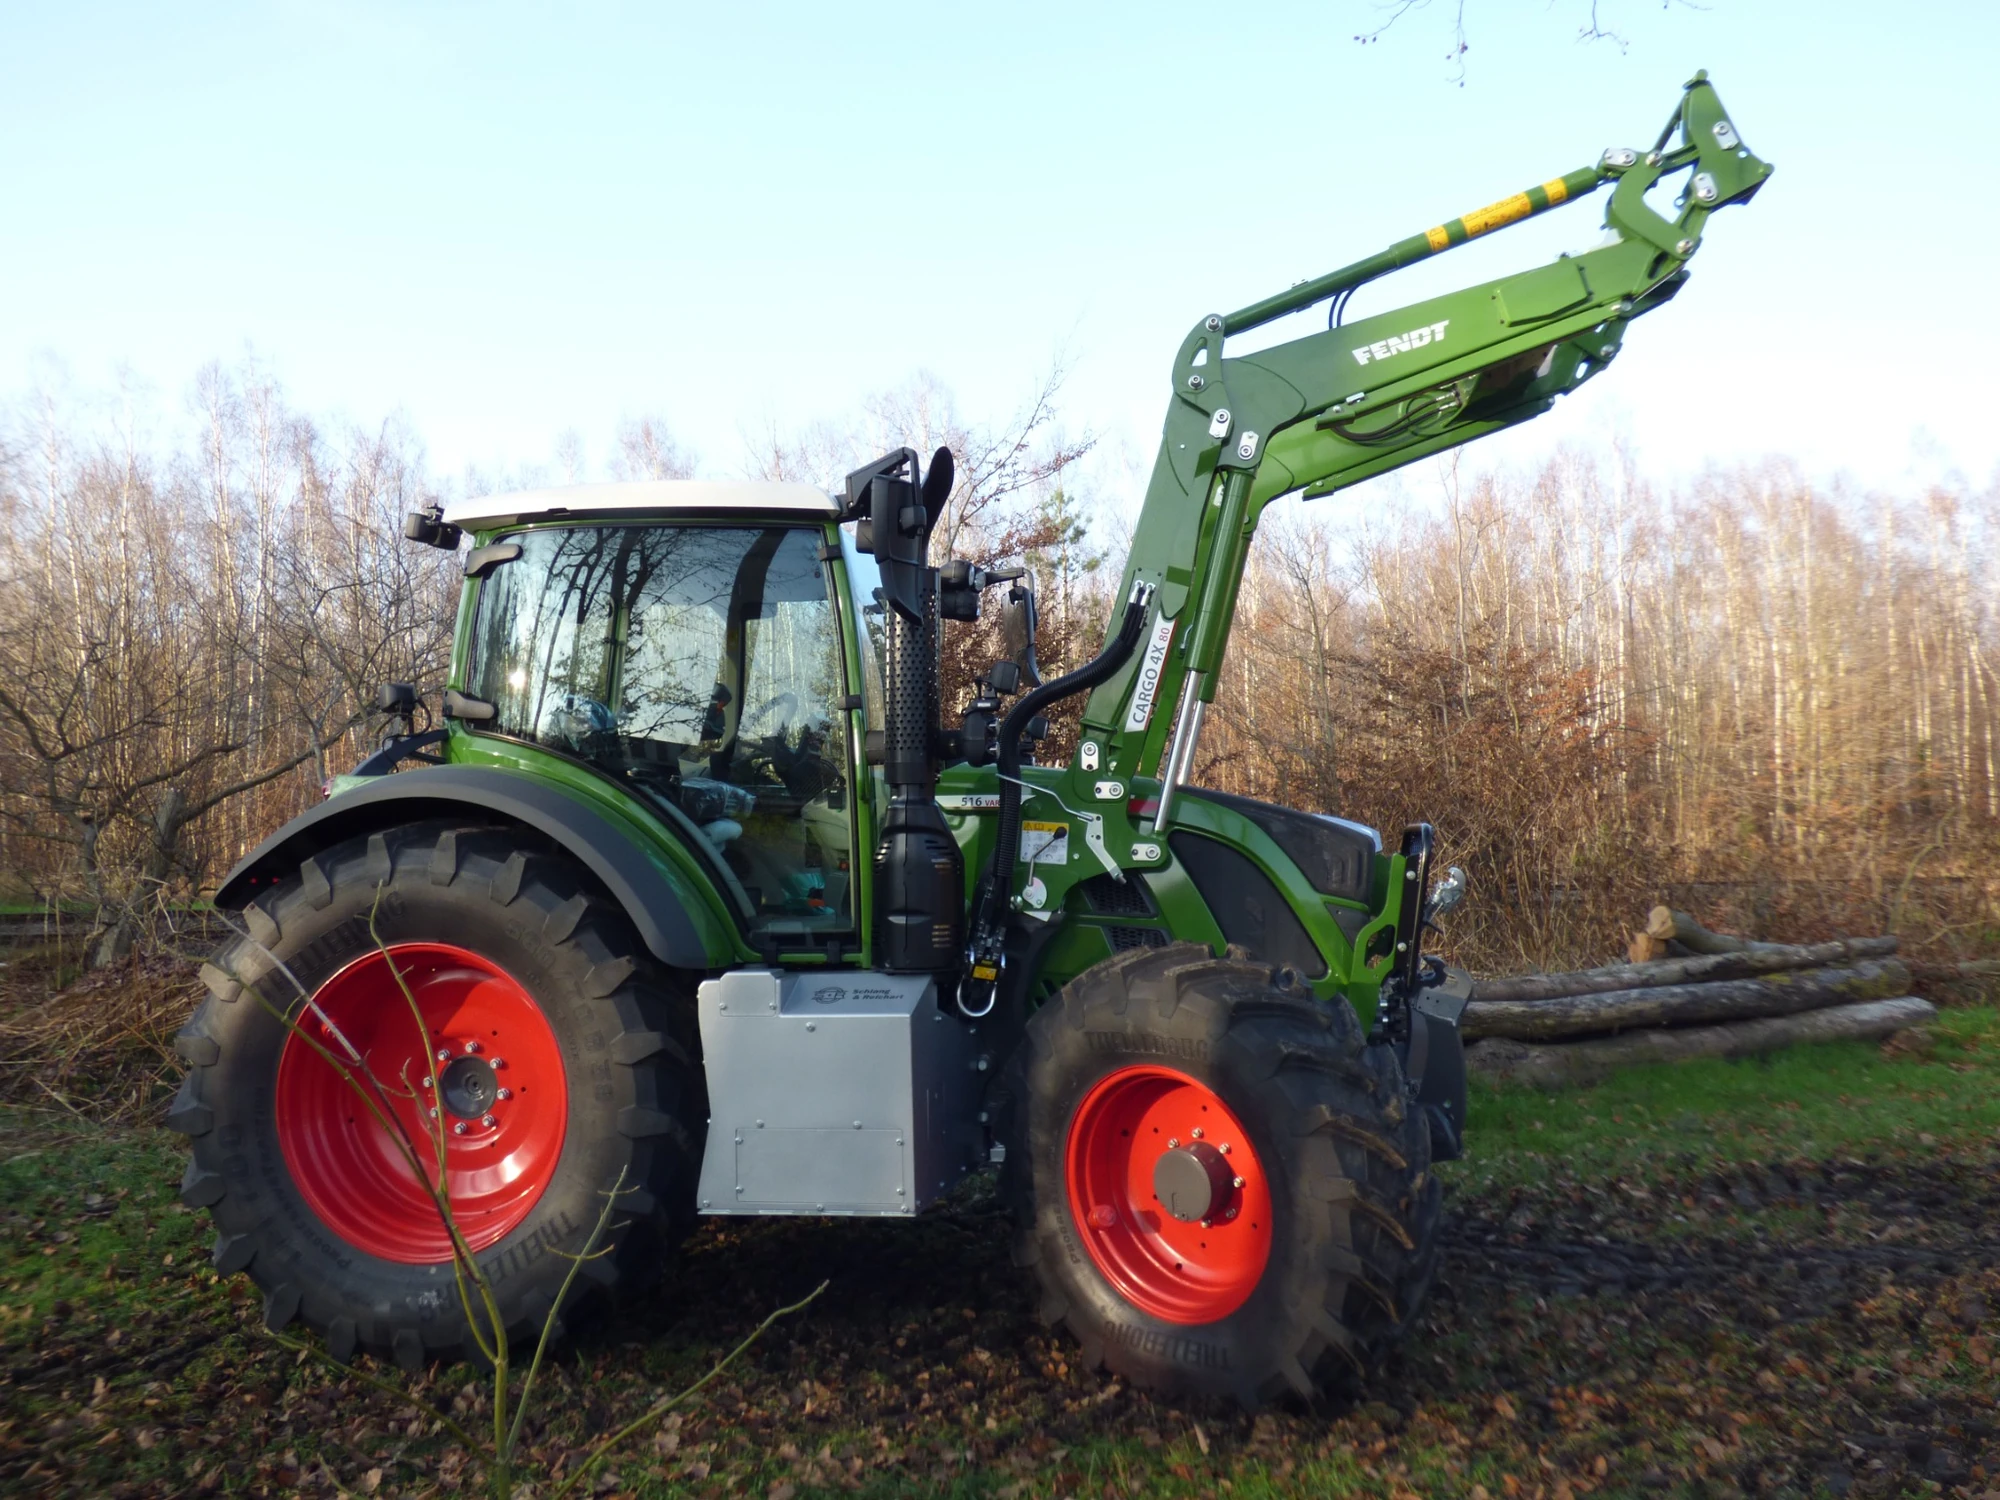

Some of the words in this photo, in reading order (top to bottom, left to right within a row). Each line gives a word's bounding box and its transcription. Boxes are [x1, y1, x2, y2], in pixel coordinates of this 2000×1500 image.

[1351, 319, 1450, 366] FENDT
[1132, 668, 1158, 724] CARGO
[1150, 644, 1165, 665] 4X
[1158, 627, 1170, 642] 80
[961, 796, 982, 807] 516
